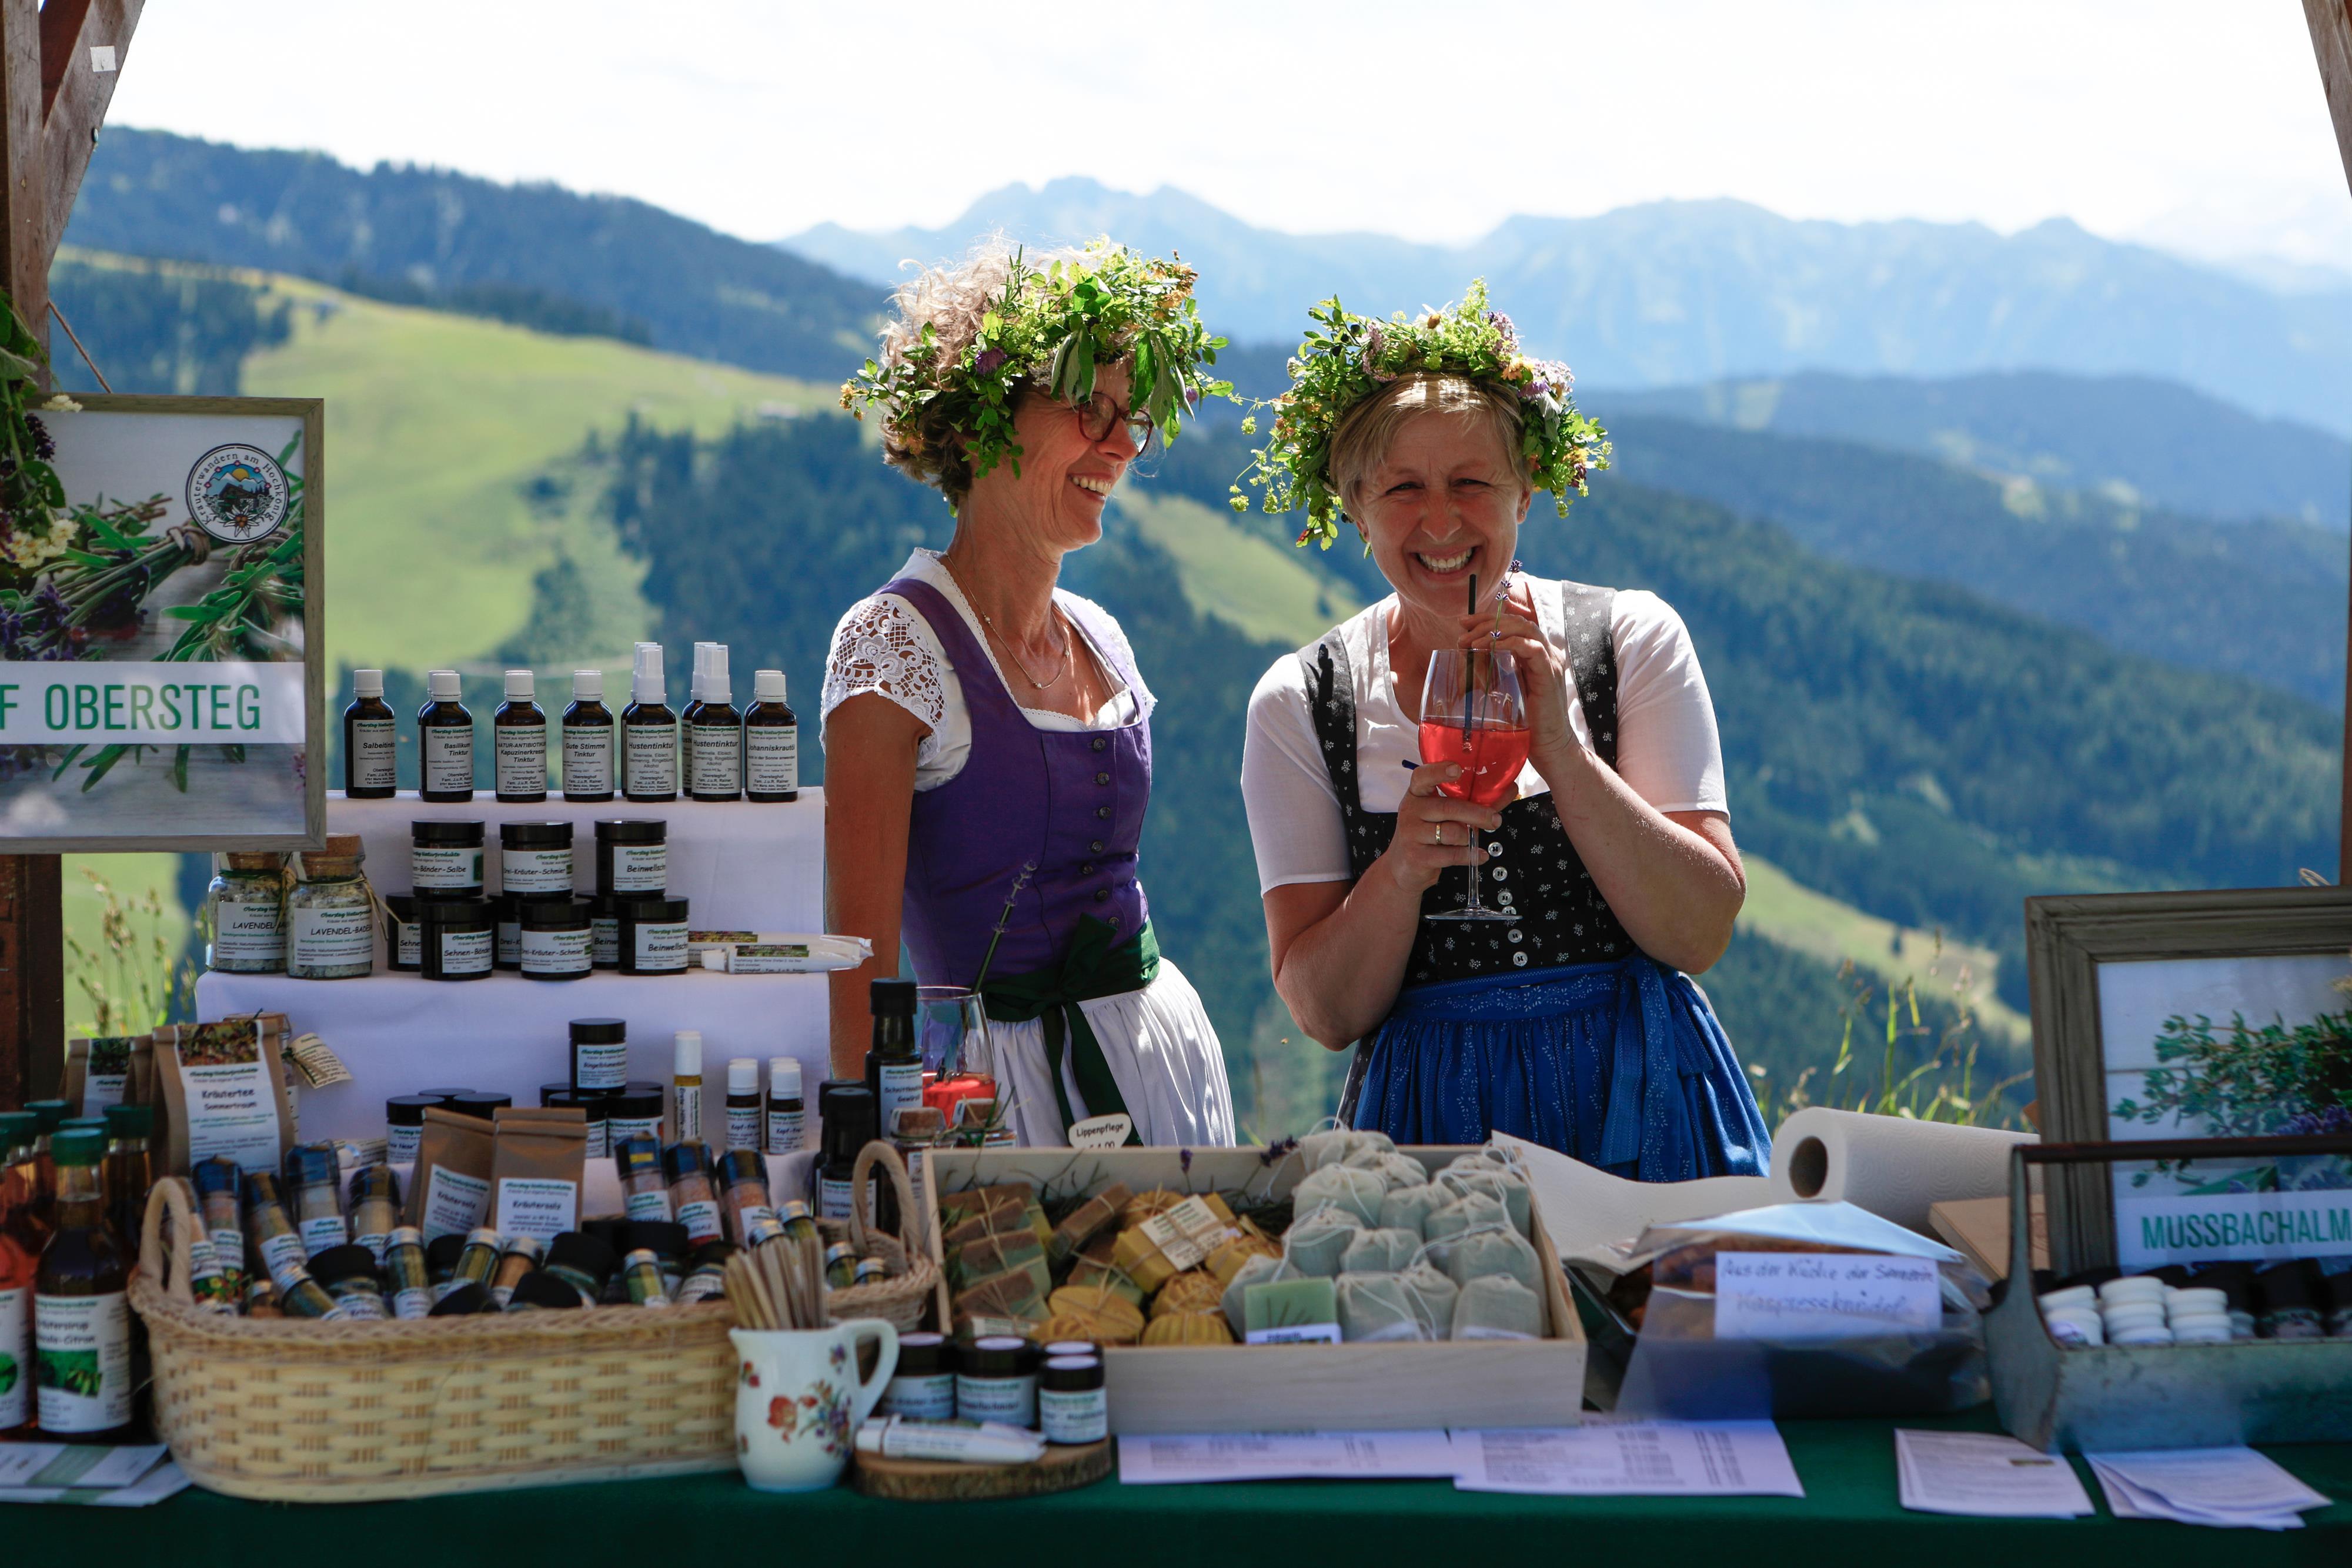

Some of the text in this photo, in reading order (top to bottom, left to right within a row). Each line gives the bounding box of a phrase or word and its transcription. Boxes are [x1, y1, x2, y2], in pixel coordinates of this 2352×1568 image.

[245, 454, 259, 464] am
[263, 464, 285, 523] Hochkönig
[44, 683, 261, 731] OBERSTEG
[202, 1089, 255, 1099] Kräutertee
[1077, 1122, 1124, 1138] Lippenpflege
[512, 1200, 561, 1211] Kräutersalz
[2140, 1206, 2352, 1251] MUSSBACHALM
[1722, 1259, 1750, 1278] Aus
[1755, 1259, 1781, 1278] der
[1788, 1257, 1838, 1279] Küche
[1846, 1263, 1869, 1281] der
